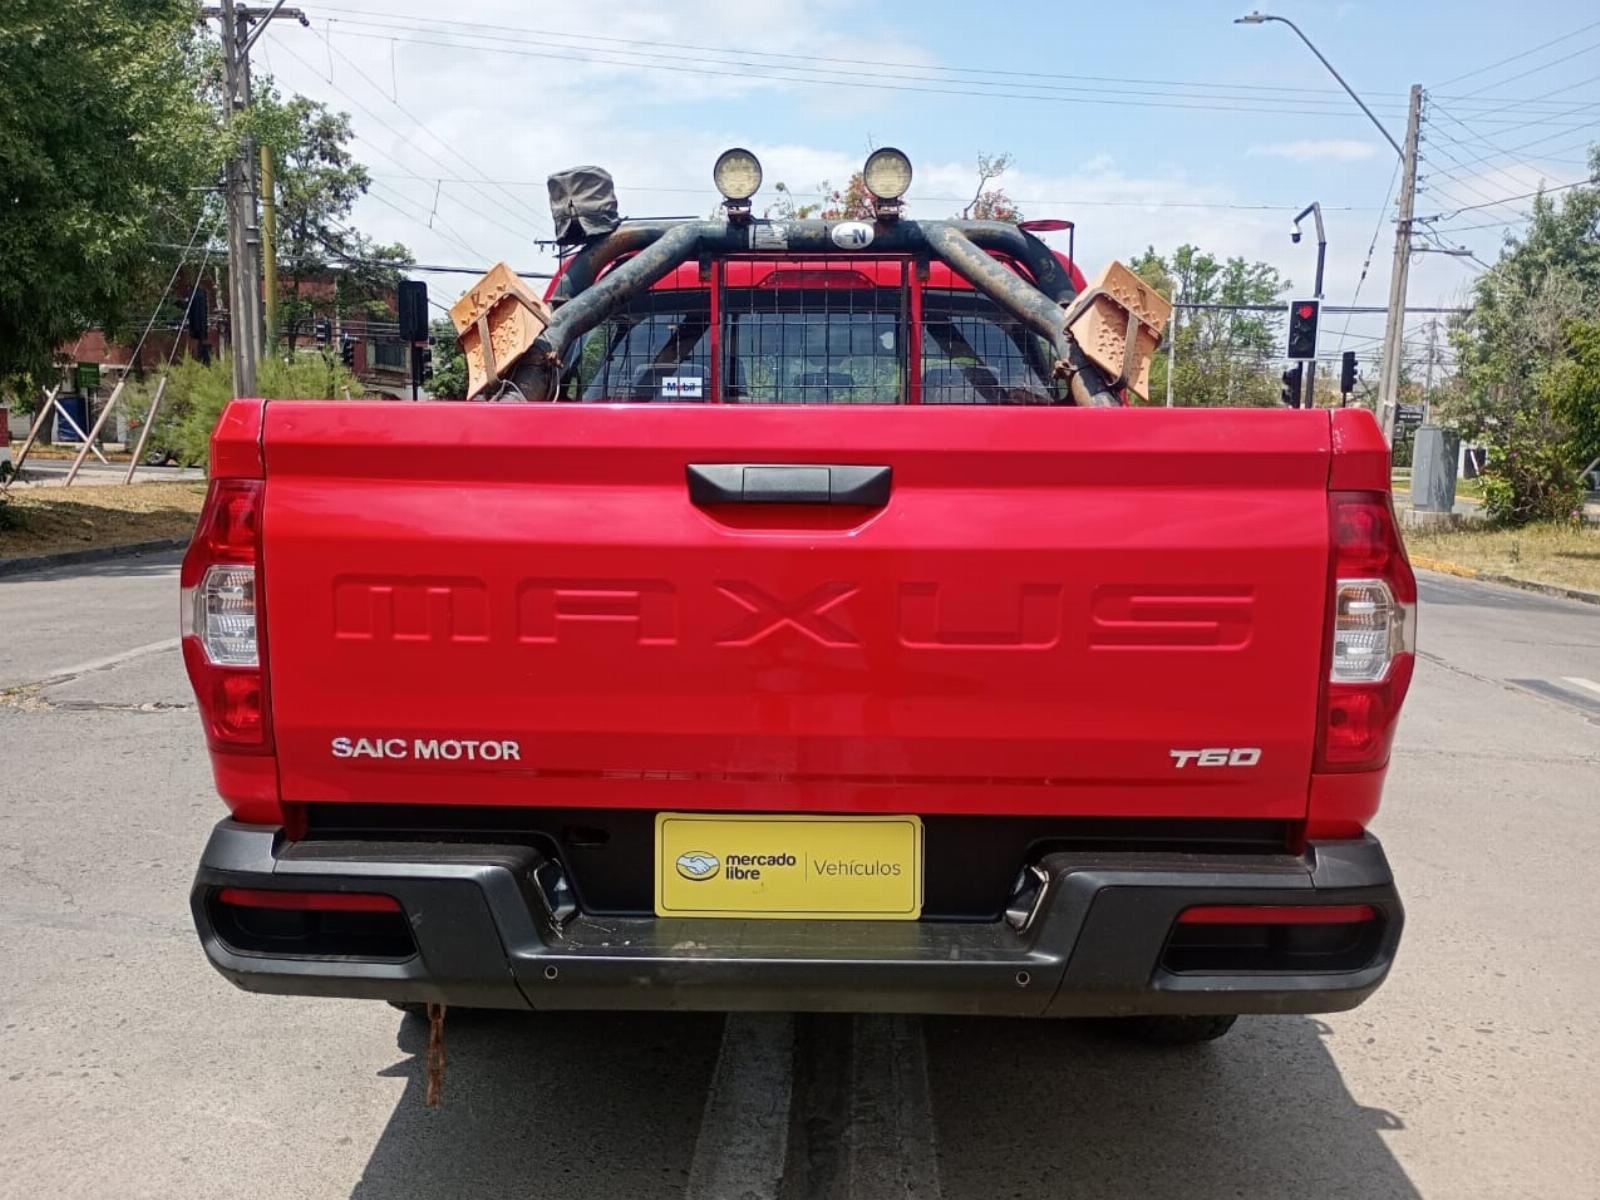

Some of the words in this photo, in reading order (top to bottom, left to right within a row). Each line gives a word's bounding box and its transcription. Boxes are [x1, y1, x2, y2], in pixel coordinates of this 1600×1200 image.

[332, 574, 1256, 651] MAXUS
[331, 737, 407, 758] SAIC
[414, 739, 521, 761] MOTOR
[1169, 748, 1262, 768] T60
[725, 852, 796, 867] mercado
[813, 858, 902, 877] Vehículos
[725, 866, 760, 880] libre
